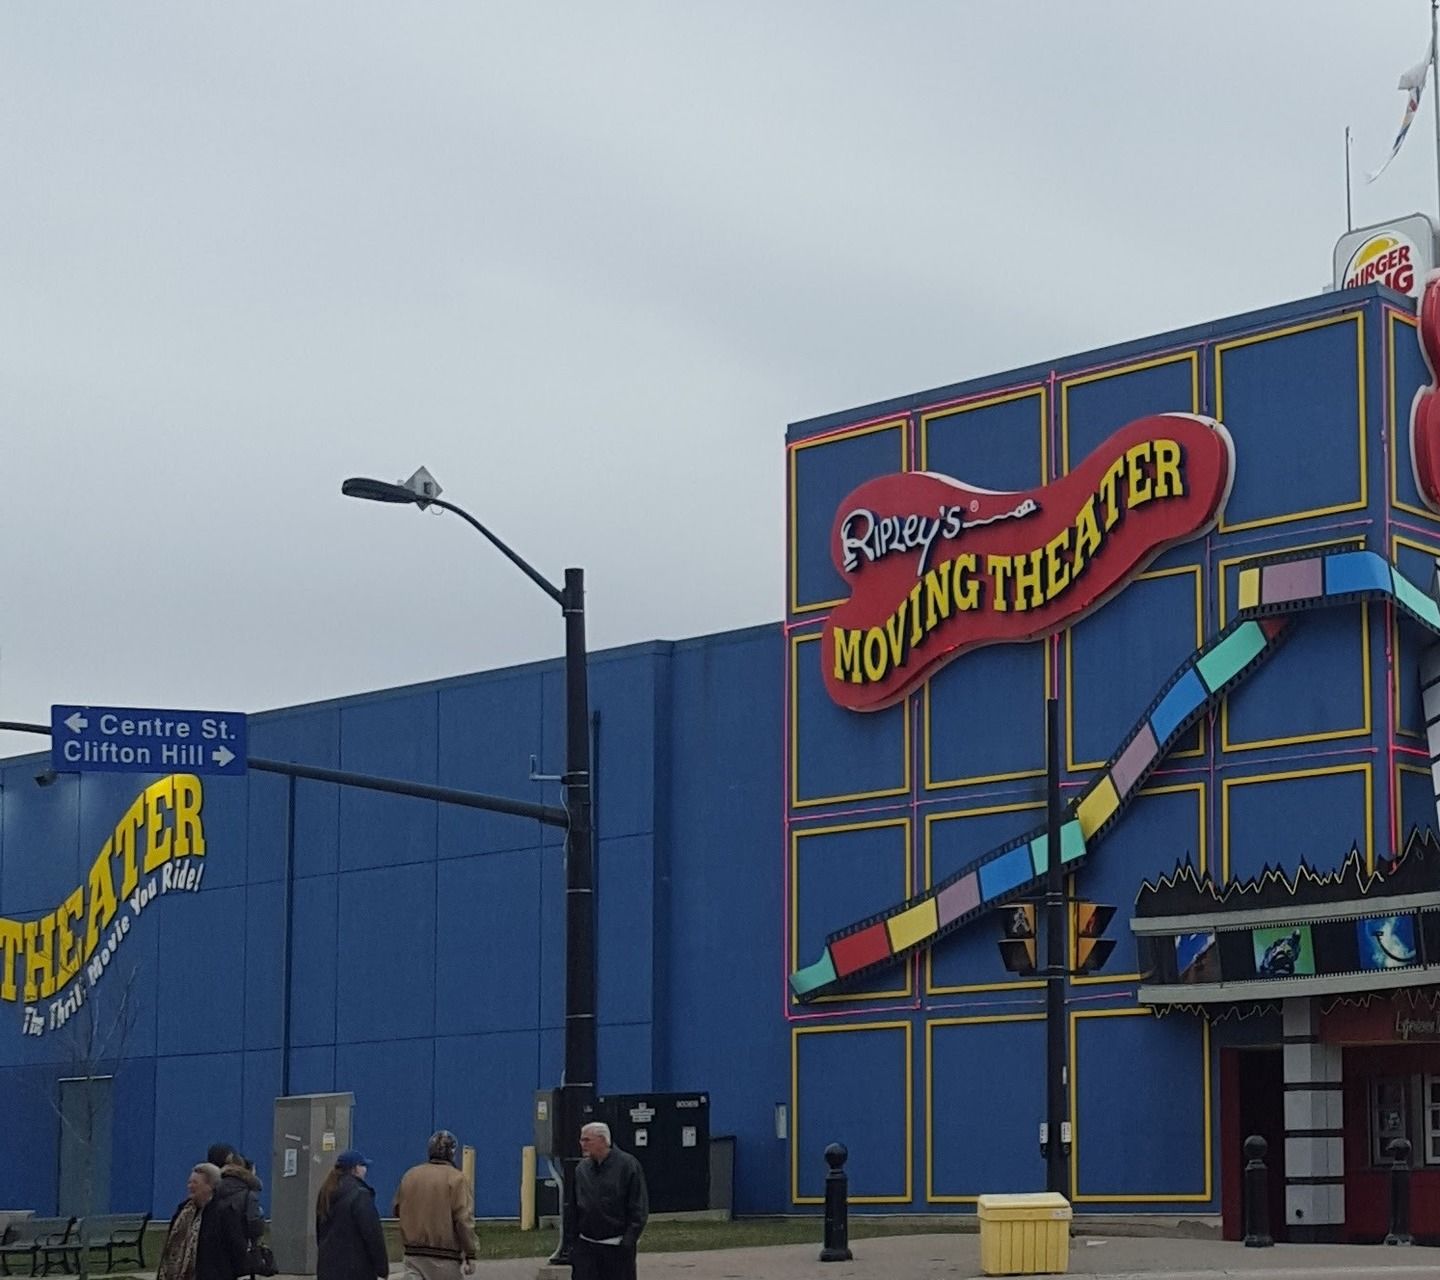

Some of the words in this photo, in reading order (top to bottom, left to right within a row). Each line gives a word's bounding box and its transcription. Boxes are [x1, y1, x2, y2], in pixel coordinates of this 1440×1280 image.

[832, 553, 980, 684] MOVING
[987, 439, 1184, 612] THEATER
[63, 740, 150, 763] Clifton
[161, 744, 204, 766] Hill
[100, 713, 191, 737] Centre
[201, 719, 237, 740] St.
[0, 773, 206, 1003] THEATER
[87, 915, 131, 986] Movie
[130, 877, 158, 916] You
[162, 859, 204, 894] Ride!
